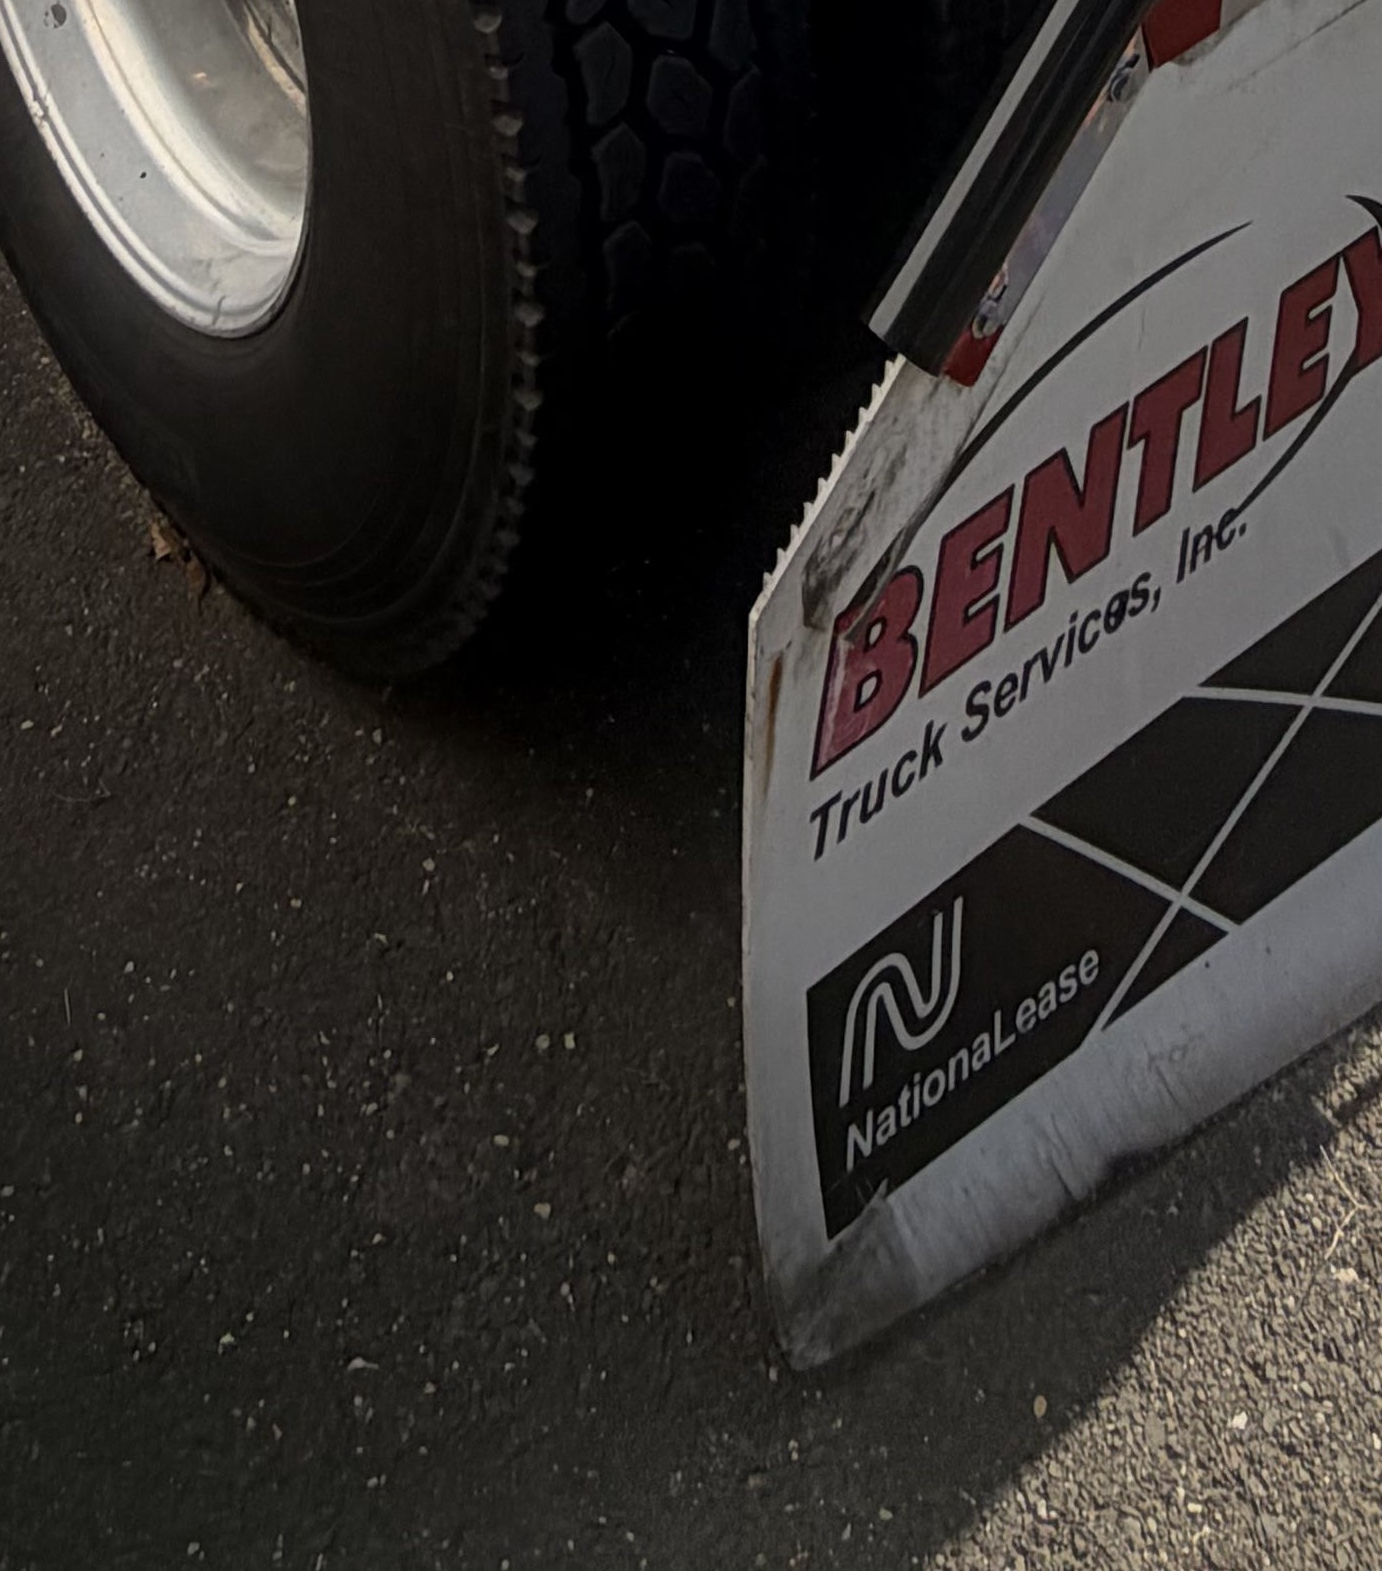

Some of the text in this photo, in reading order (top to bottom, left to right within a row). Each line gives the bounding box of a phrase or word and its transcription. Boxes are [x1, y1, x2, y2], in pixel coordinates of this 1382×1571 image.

[810, 502, 1248, 860] Truck Services, Inc.
[845, 947, 1100, 1172] NationaLease
